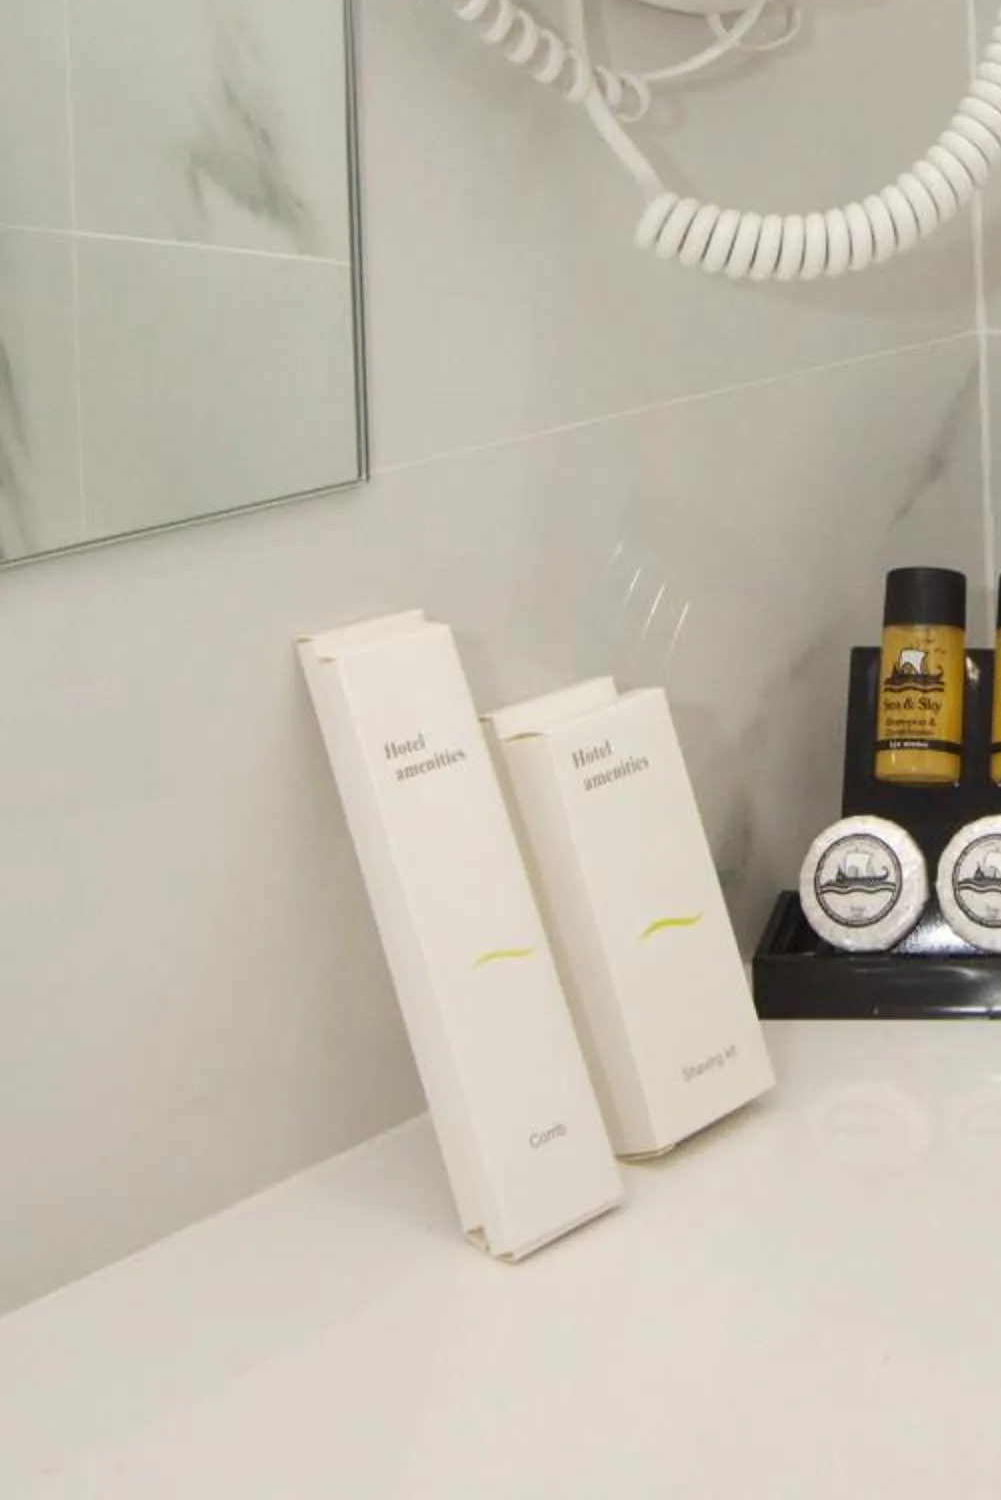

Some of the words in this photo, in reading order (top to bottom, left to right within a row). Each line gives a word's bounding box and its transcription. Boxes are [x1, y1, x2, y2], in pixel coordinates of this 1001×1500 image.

[383, 732, 426, 761] Hotel
[572, 739, 612, 769] Hotel
[395, 749, 467, 781] amenities
[583, 755, 650, 792] amenities
